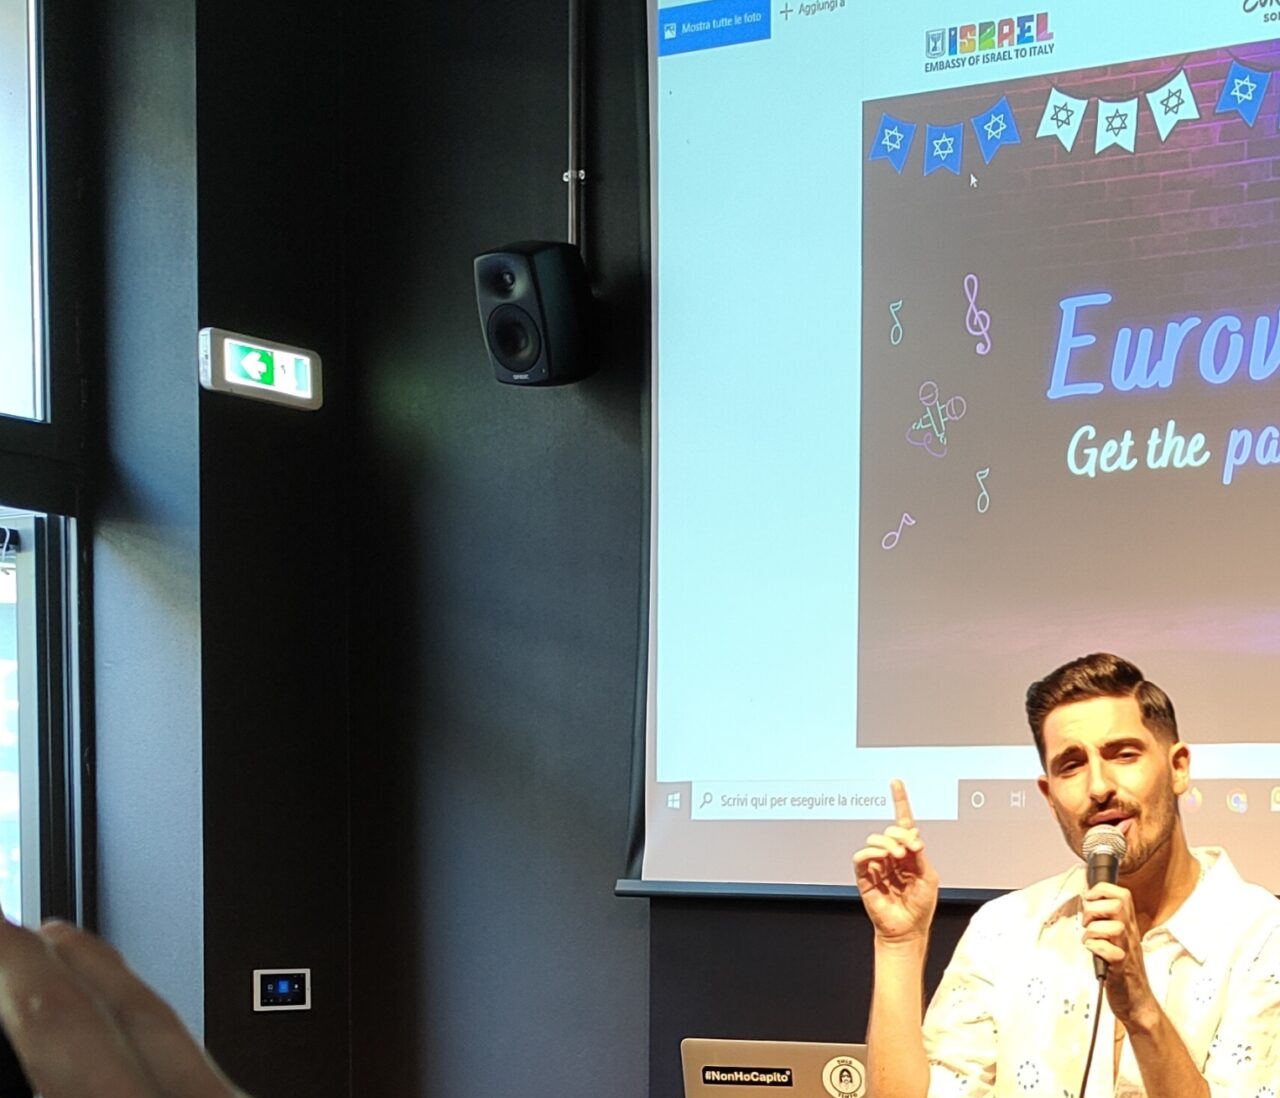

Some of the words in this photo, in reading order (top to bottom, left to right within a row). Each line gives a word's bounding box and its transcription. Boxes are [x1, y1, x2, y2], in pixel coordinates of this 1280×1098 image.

[682, 20, 711, 34] Mostra
[713, 15, 733, 30] tutte
[734, 13, 743, 26] le
[744, 11, 762, 25] foto
[948, 12, 1054, 56] ISRAEL
[924, 57, 966, 73] EMBASSY
[968, 55, 980, 66] OF
[982, 51, 1013, 64] ISRAEL
[1014, 48, 1027, 58] TO
[1029, 43, 1055, 56] ITALY
[1066, 424, 1138, 478] Get
[1146, 419, 1211, 470] the
[721, 793, 749, 807] Scrivi
[751, 793, 768, 810] qui
[770, 796, 788, 809] per
[790, 793, 835, 810] eseguire
[838, 793, 848, 806] la
[850, 793, 887, 807] ricerca
[705, 1070, 789, 1084] #NonHoCapito
